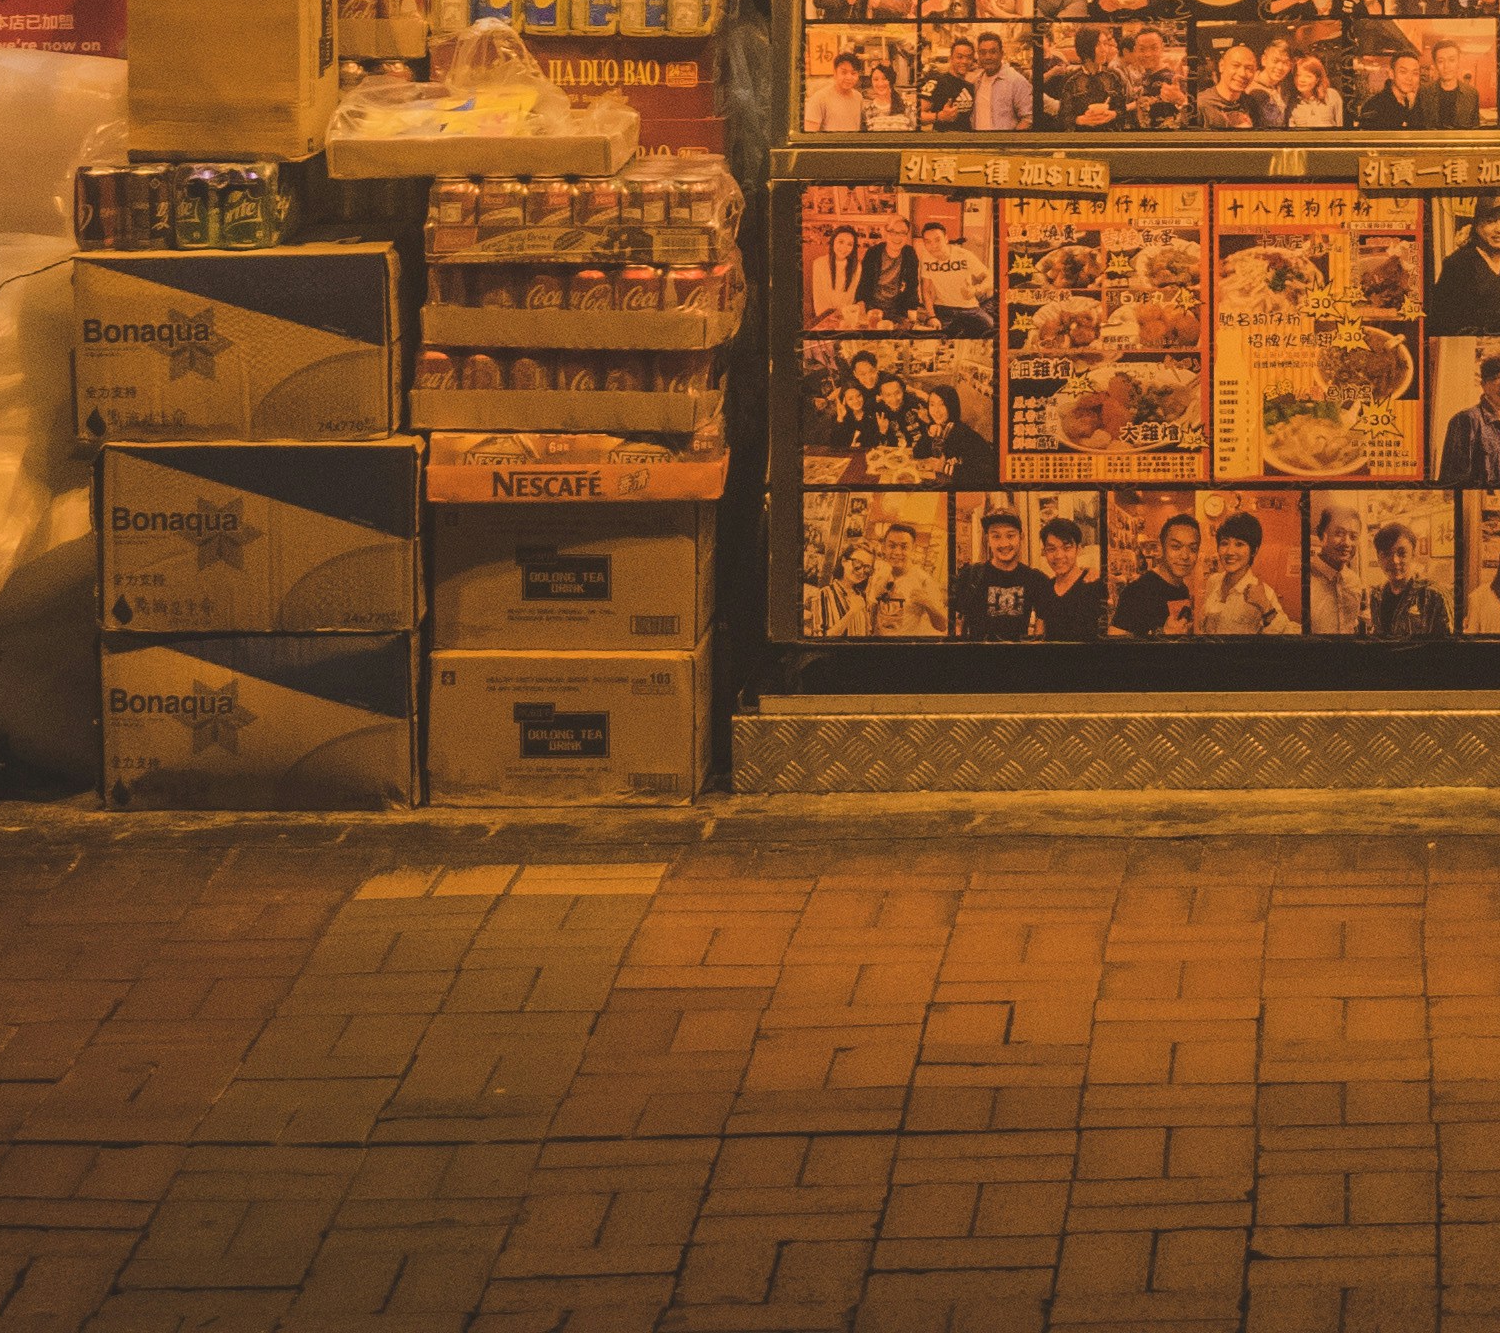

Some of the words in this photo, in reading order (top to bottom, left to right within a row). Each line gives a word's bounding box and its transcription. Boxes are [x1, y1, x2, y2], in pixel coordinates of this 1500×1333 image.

[42, 40, 76, 51] now
[81, 40, 101, 51] on
[578, 59, 619, 86] DUO
[623, 60, 661, 86] BAO
[905, 153, 1011, 188] 外賣一律
[1365, 154, 1469, 187] 外賣一律
[1227, 197, 1374, 218] 十八座狗仔粉
[83, 317, 211, 346] Bonaqua
[491, 470, 603, 498] NESCAFÉ
[111, 506, 239, 535] Bonaqua
[110, 687, 234, 715] Bonaqua
